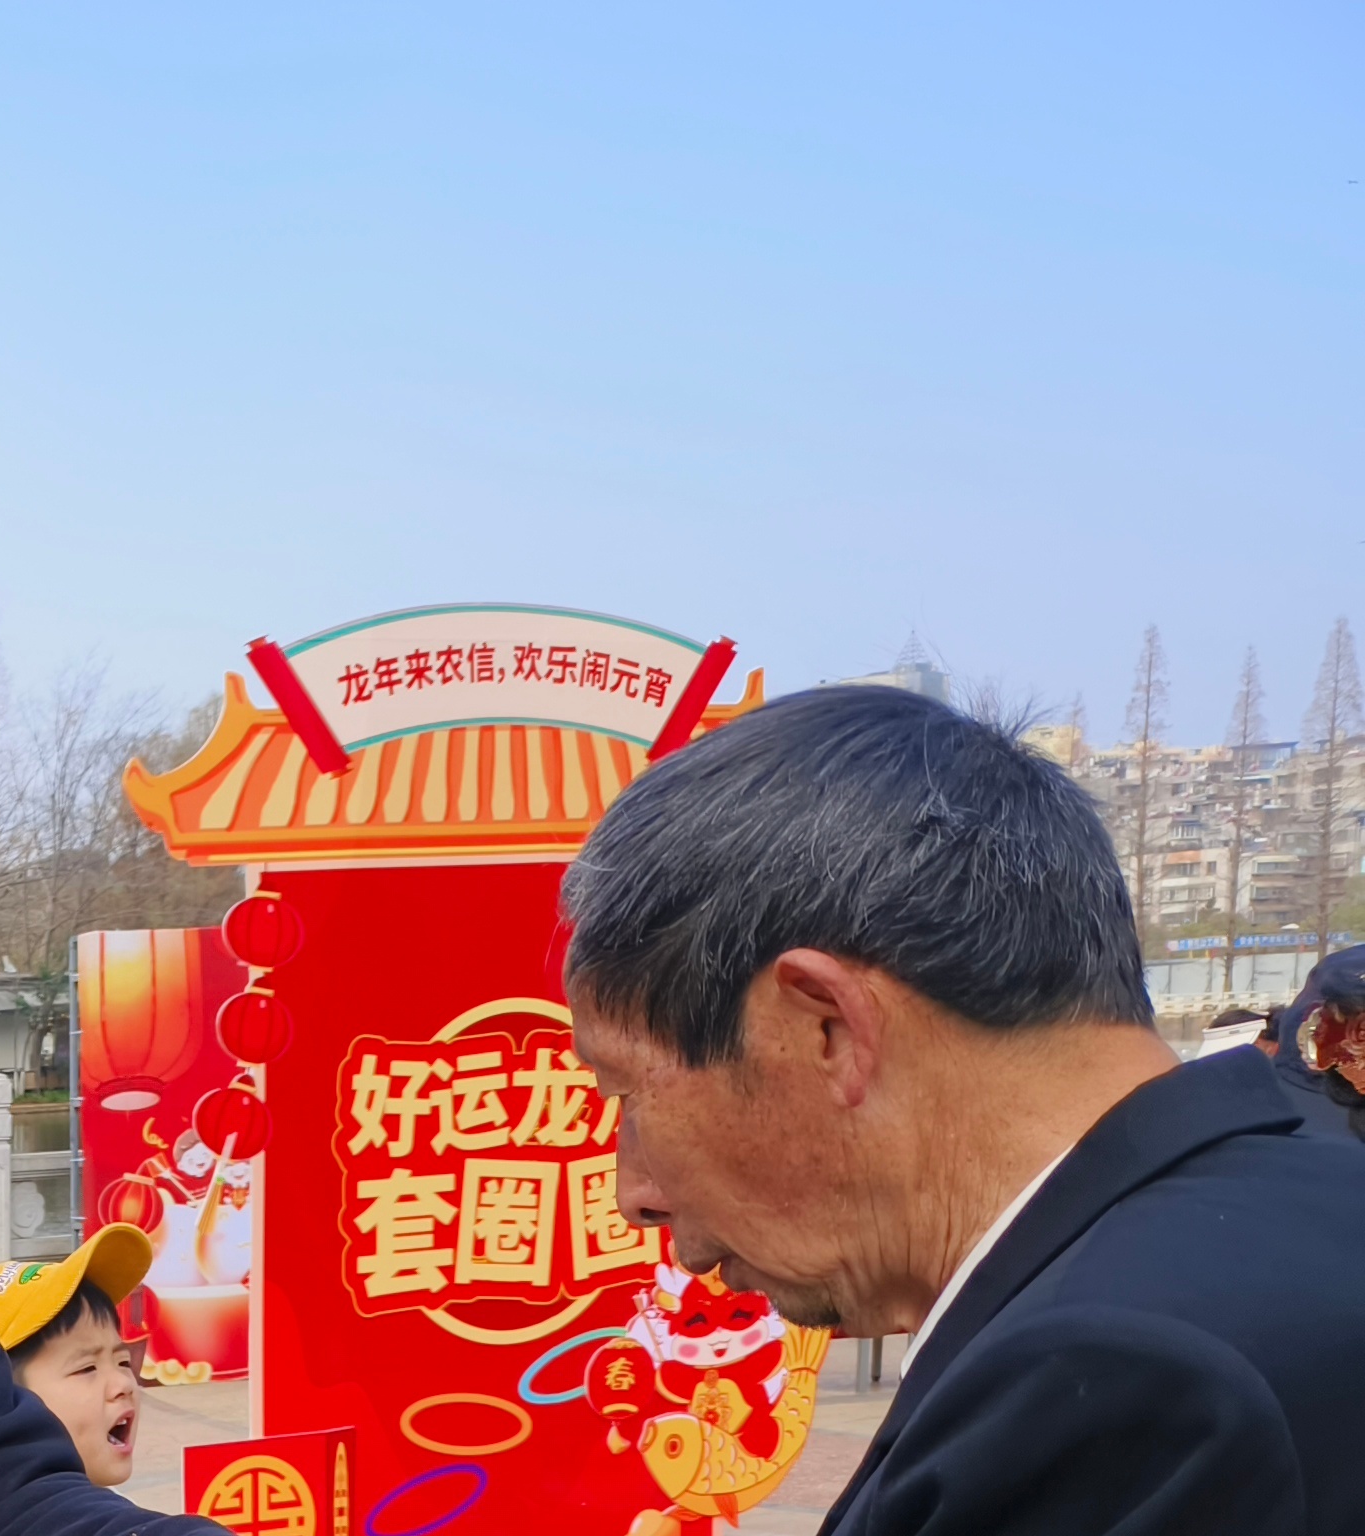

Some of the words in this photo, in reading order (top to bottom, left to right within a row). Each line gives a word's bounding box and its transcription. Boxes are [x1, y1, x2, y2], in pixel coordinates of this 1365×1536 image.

[346, 1047, 619, 1158] 好运龙
[604, 1356, 636, 1391] 春
